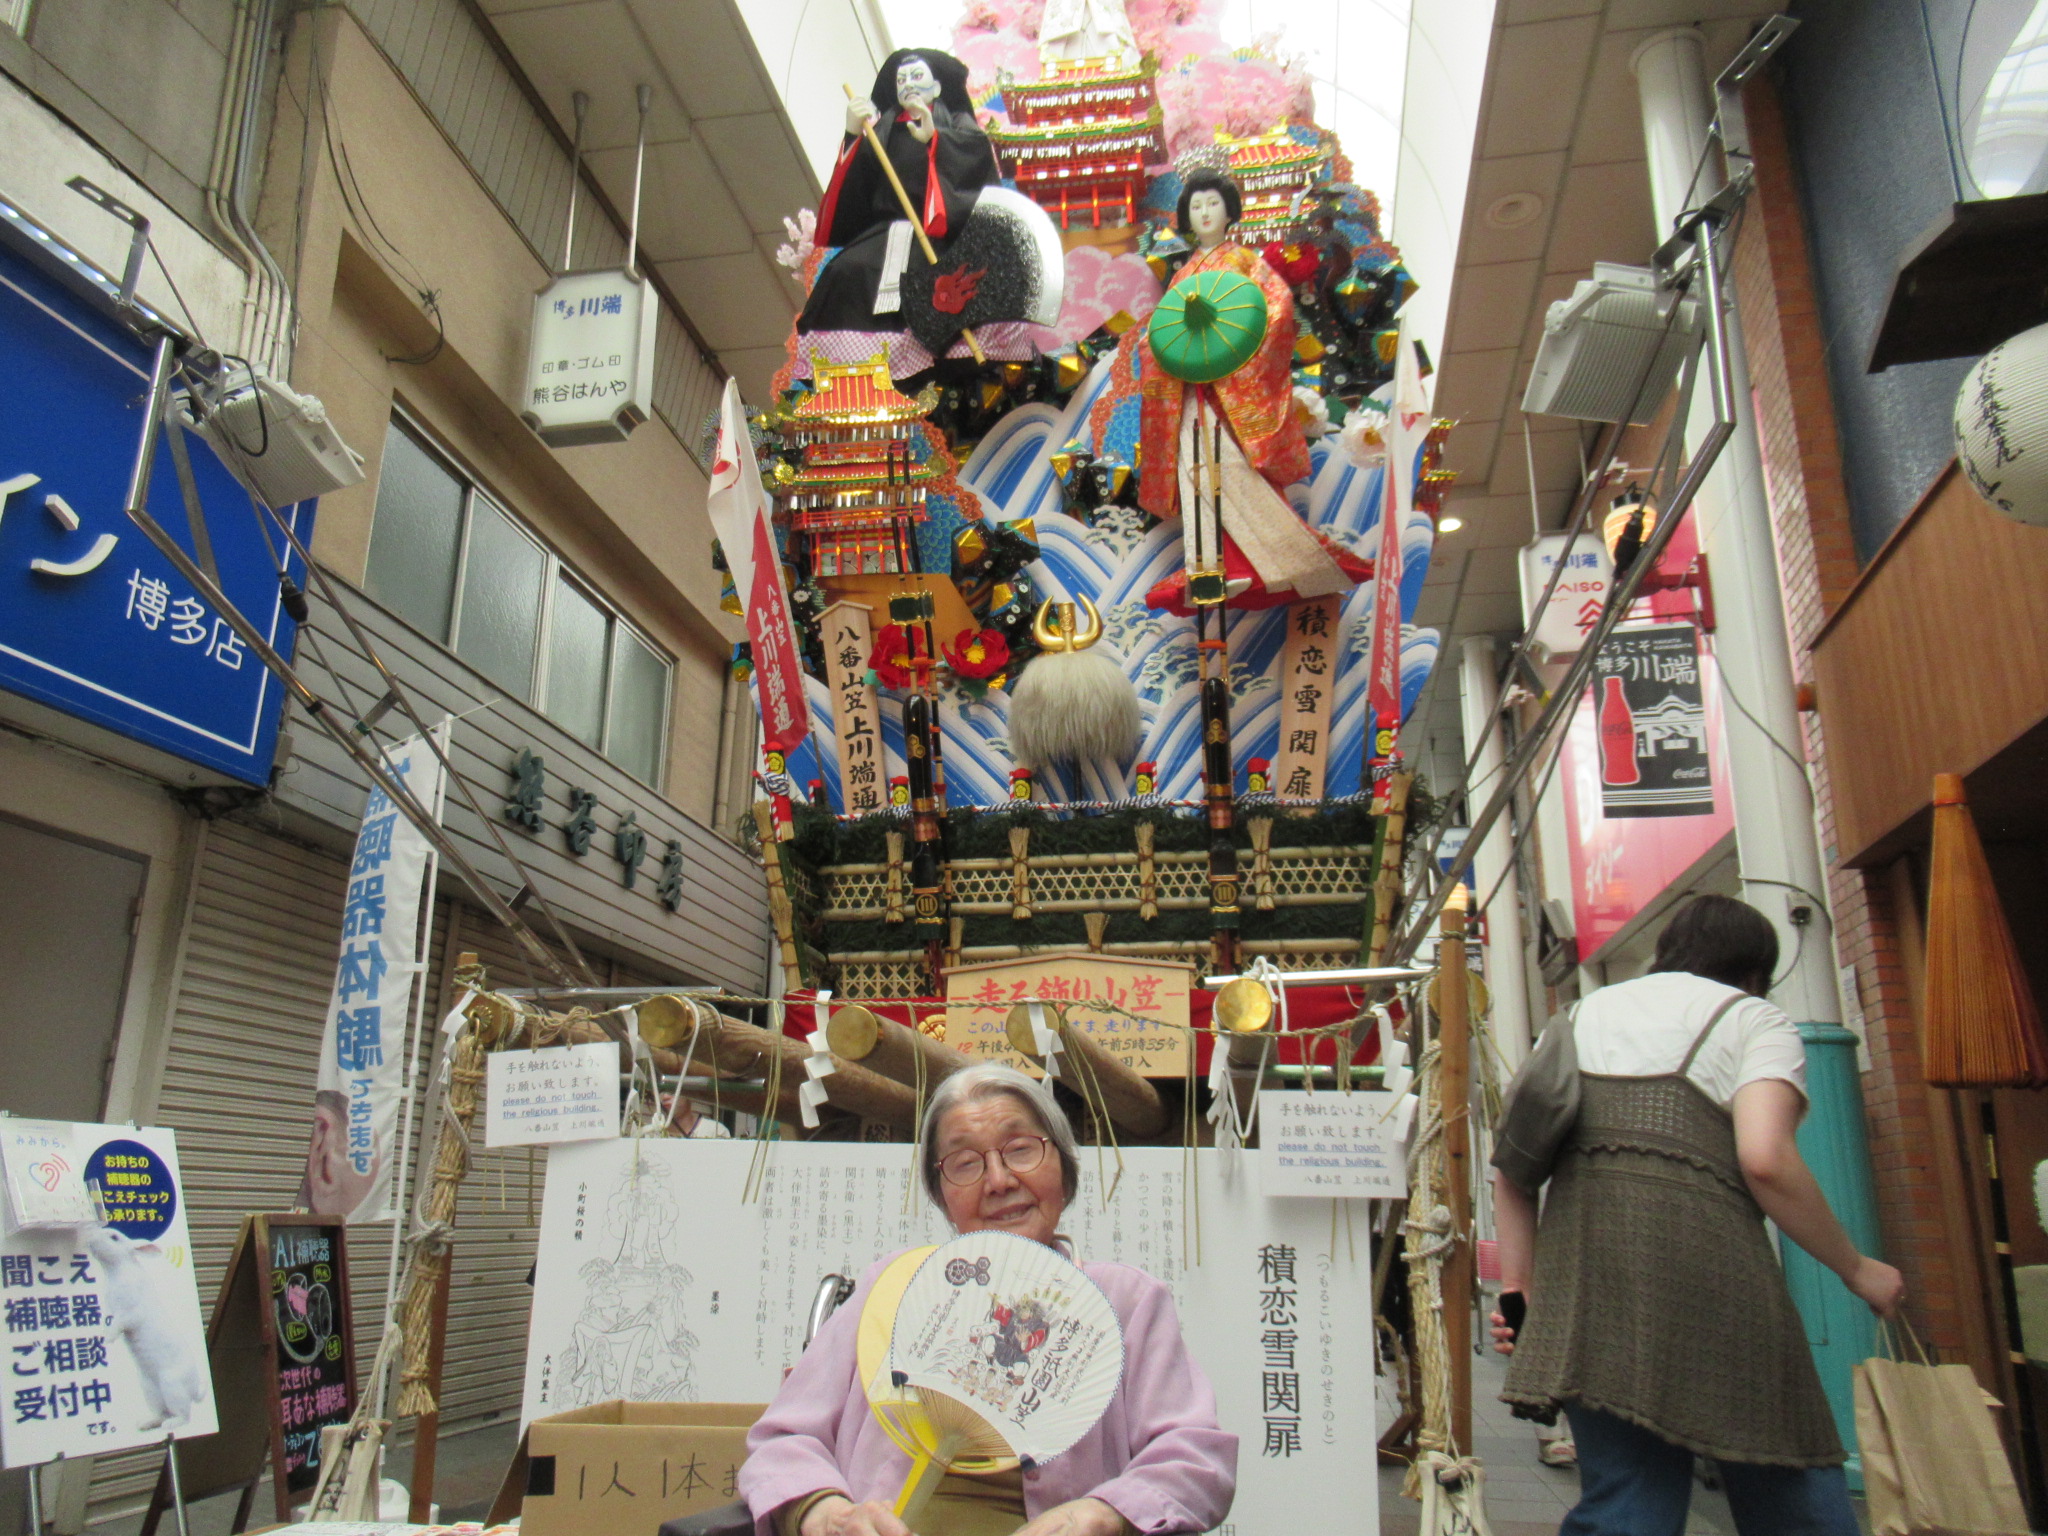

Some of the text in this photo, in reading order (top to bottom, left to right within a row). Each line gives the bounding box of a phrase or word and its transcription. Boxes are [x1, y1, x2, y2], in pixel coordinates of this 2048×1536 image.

[532, 380, 627, 405] 熊谷はんや
[1543, 581, 1604, 592] AISO
[127, 568, 247, 670] 博多店
[757, 607, 795, 735] 上川端通
[1595, 654, 1697, 685] 博多川端
[1284, 605, 1330, 798] 積恋雪関扉
[503, 1097, 530, 1106] please
[536, 1095, 547, 1103] do
[572, 1091, 597, 1100] touch
[522, 1107, 558, 1117] religious
[1278, 1143, 1308, 1152] please
[1314, 1142, 1326, 1150] do
[1332, 1142, 1347, 1150] not
[1279, 1156, 1294, 1165] the
[1300, 1156, 1339, 1167] religious
[92, 1190, 170, 1204] こえチェック
[1, 1253, 97, 1289] 聞こえ
[12, 1335, 109, 1377] ご相談
[1257, 1243, 1302, 1459] 積恋雪関扉
[13, 1378, 112, 1424] 受付中
[87, 1421, 118, 1436] です。
